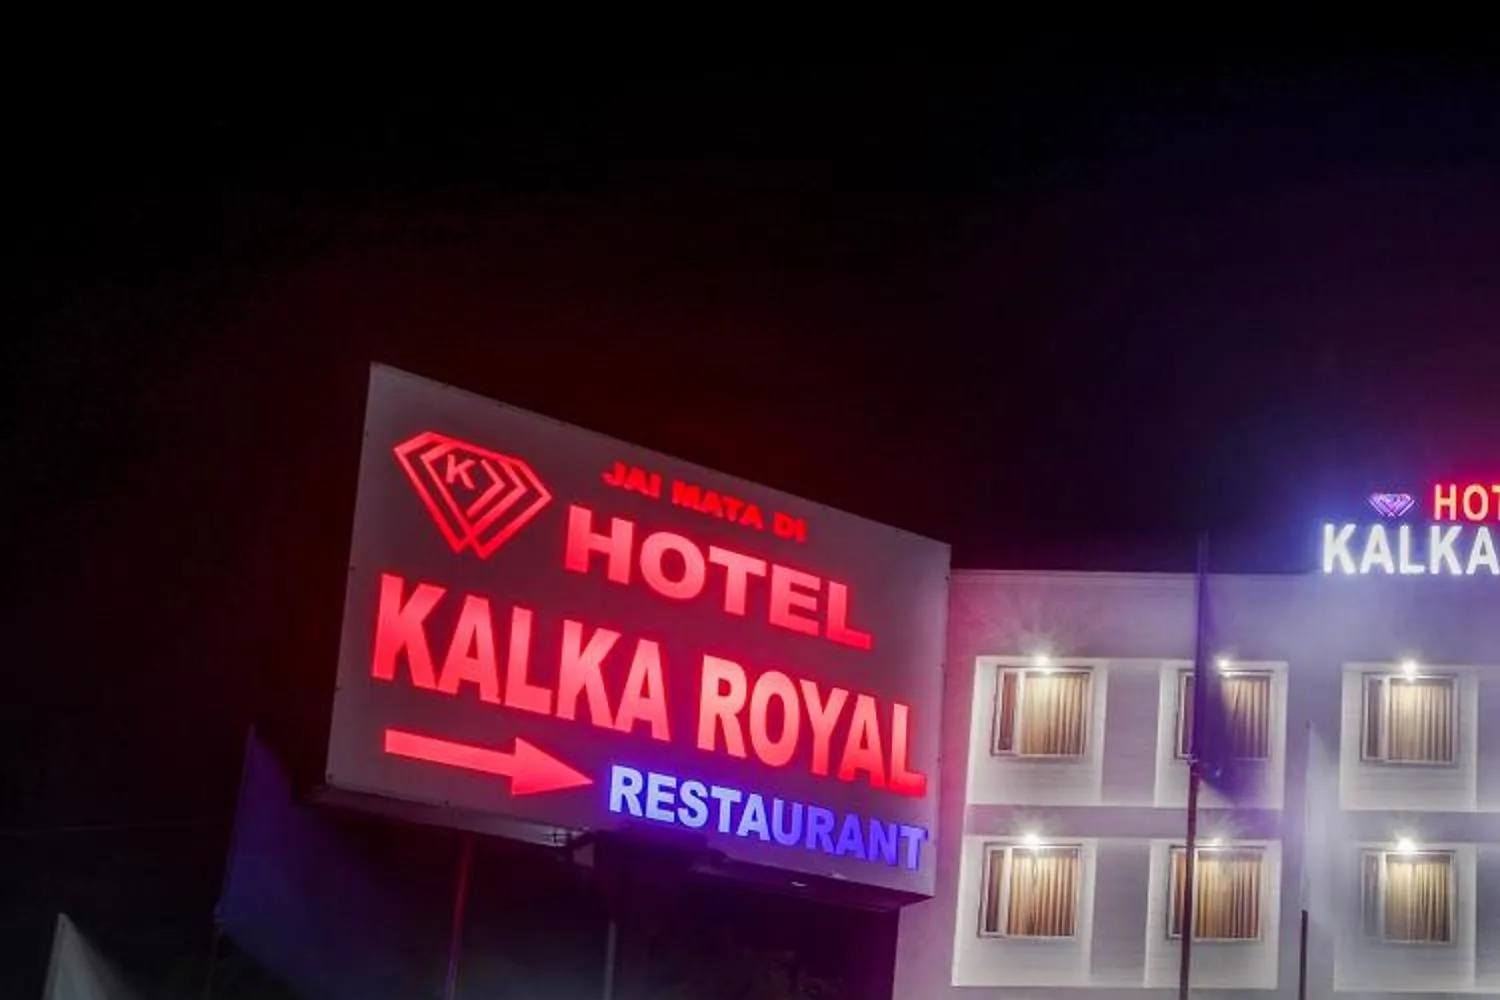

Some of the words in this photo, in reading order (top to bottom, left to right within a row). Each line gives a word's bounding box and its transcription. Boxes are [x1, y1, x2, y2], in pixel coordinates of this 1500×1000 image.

[602, 461, 662, 499] JAI
[672, 479, 764, 530] MATA
[774, 512, 807, 541] DI
[1323, 524, 1500, 575] KALKA
[564, 505, 872, 650] HOTEL
[372, 572, 670, 741] KALKA
[697, 654, 927, 797] ROYAL
[609, 765, 929, 870] RESTAURANT
